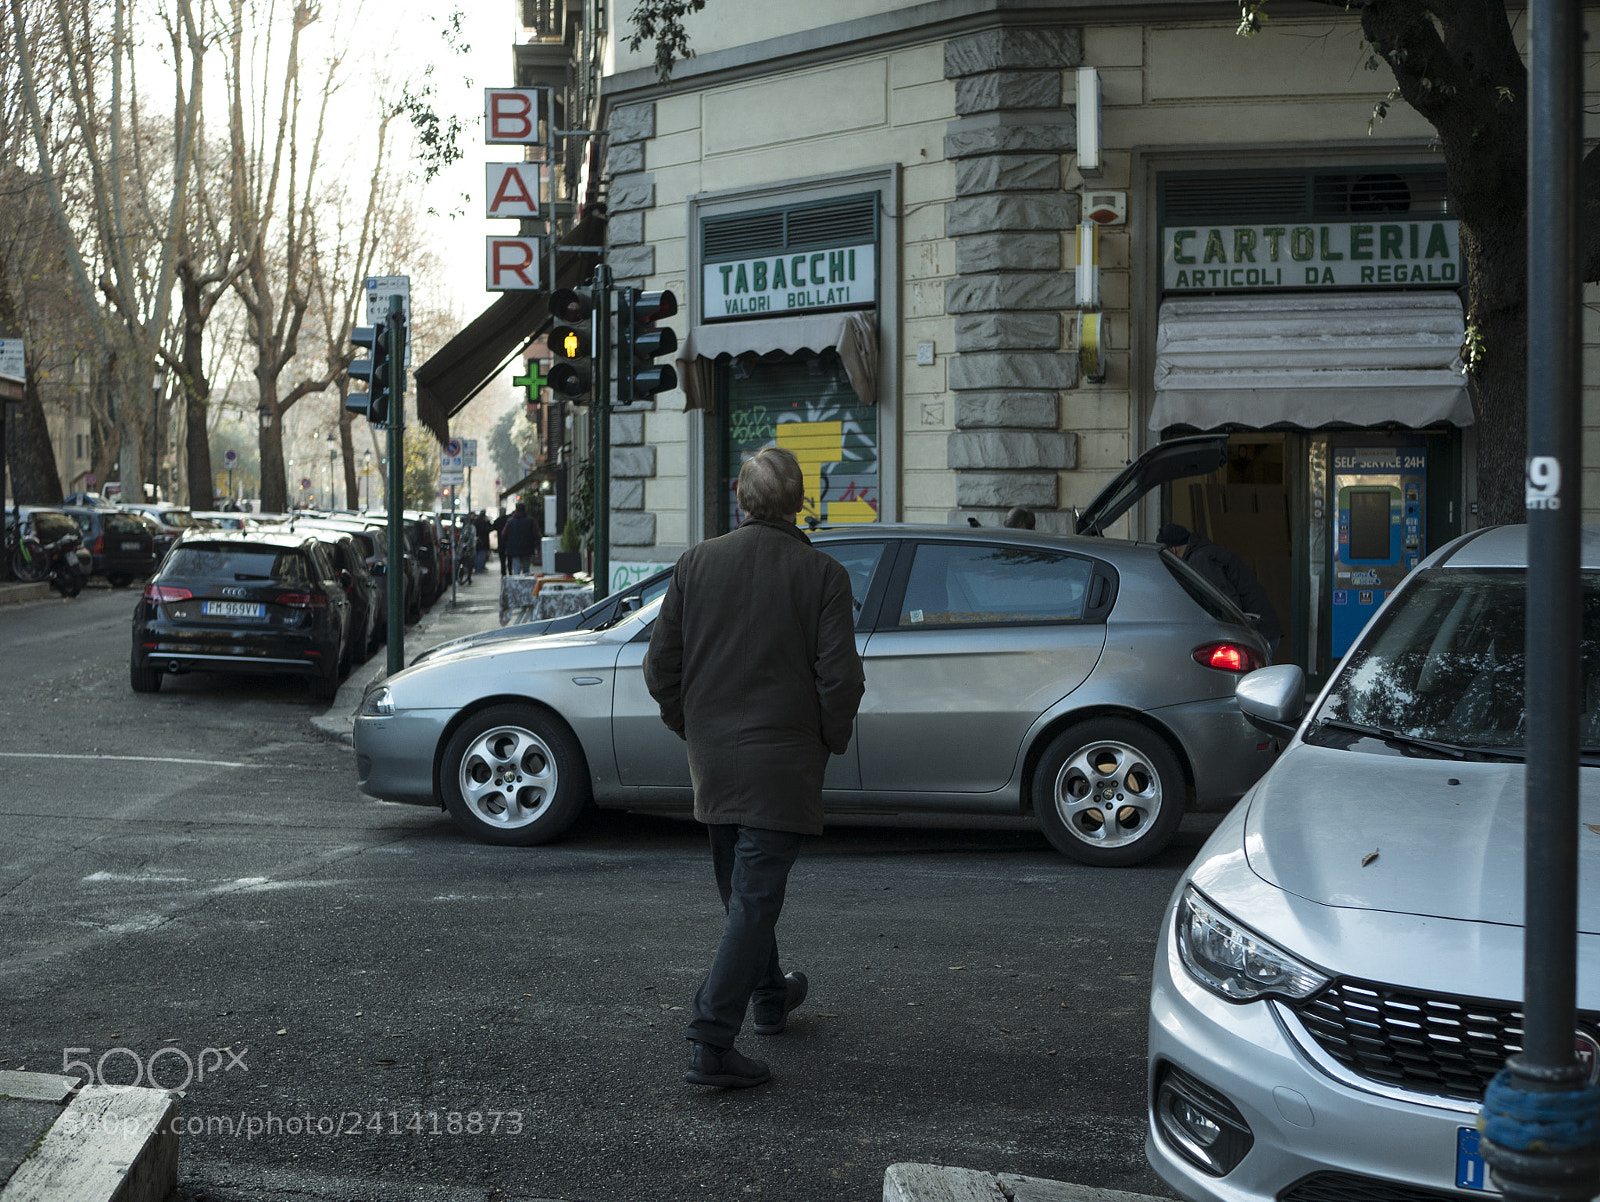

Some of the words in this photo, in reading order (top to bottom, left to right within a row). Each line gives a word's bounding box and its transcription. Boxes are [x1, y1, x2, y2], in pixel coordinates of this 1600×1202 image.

[490, 93, 536, 286] BAR
[1174, 223, 1450, 264] CARTOLERIA
[719, 249, 855, 295] TABACCHI
[1176, 268, 1281, 287] ARTICOLI
[1305, 267, 1335, 284] DA
[1361, 263, 1456, 283] REGALO
[725, 295, 770, 314] VALORI
[787, 286, 850, 308] BOLLATI
[1334, 456, 1356, 468] SELF
[1404, 456, 1425, 468] 24H
[1530, 456, 1561, 497] 9
